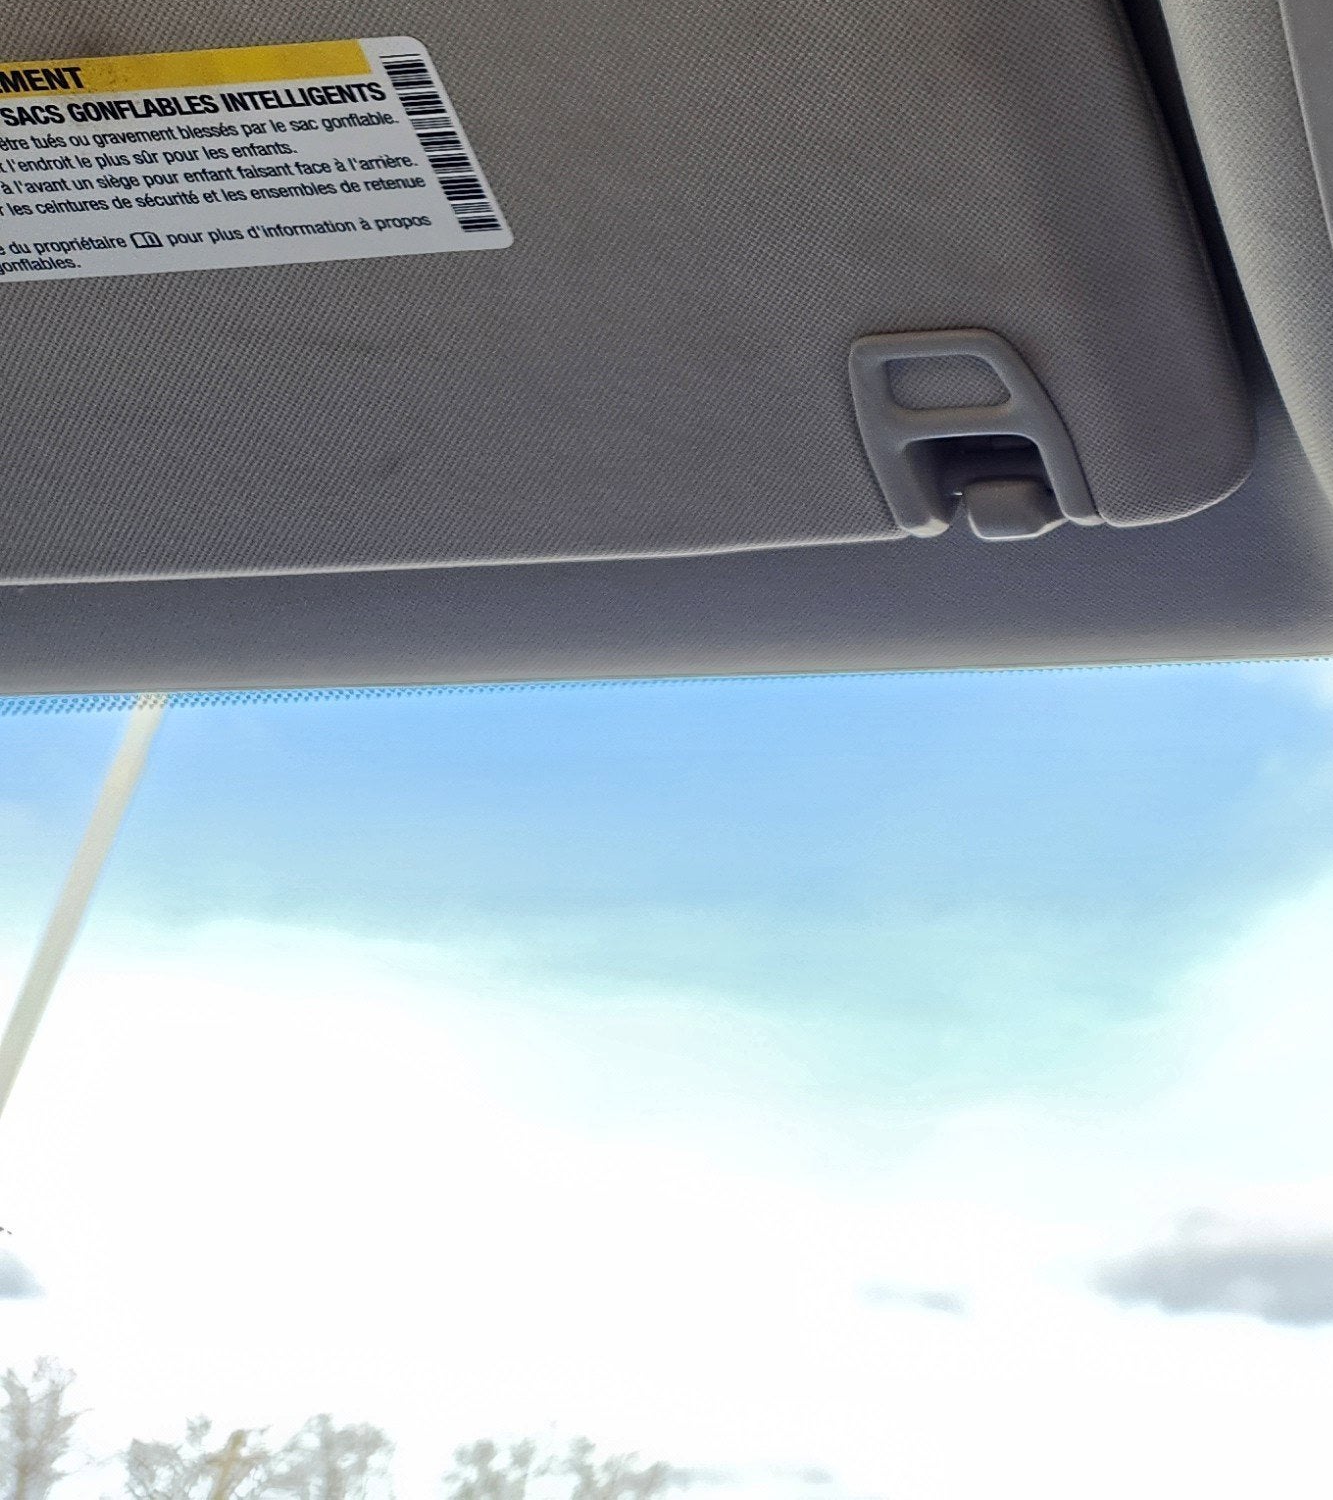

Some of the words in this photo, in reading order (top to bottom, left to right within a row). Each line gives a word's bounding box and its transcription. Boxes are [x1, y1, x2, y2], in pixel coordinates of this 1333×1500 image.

[0, 67, 83, 93] MENT
[0, 104, 65, 126] SACS
[67, 94, 219, 123] GONFLABLES
[220, 82, 386, 112] INTELLIGENTS
[30, 134, 67, 149] tués
[69, 134, 90, 147] ou
[92, 126, 176, 148] gravement
[176, 122, 244, 140] blessés
[241, 124, 267, 142] par
[270, 119, 286, 134] le
[290, 120, 319, 133] sac
[321, 112, 400, 133] gonflable.
[1, 178, 14, 195] à
[13, 177, 72, 194] l'avant
[72, 178, 94, 191] un
[96, 174, 140, 191] siège
[143, 172, 179, 188] pour
[184, 166, 237, 184] enfant
[236, 161, 293, 180] faisant
[294, 159, 332, 176] face
[334, 157, 346, 173] à
[348, 153, 418, 172] l'arrière.
[9, 155, 75, 173] l'endroit
[75, 154, 93, 169] le
[95, 152, 131, 170] plus
[133, 149, 160, 165] sûr
[162, 149, 199, 166] pour
[202, 146, 229, 161] les
[231, 141, 298, 159] enfants.
[7, 202, 33, 217] les
[35, 198, 109, 214] ceintures
[112, 196, 133, 210] de
[135, 190, 200, 208] sécurité
[202, 189, 222, 204] et
[222, 186, 248, 201] les
[250, 180, 338, 200] ensembles
[340, 180, 361, 194] de
[364, 175, 426, 192] retenue
[8, 241, 31, 256] du
[33, 235, 128, 257] propriétaire
[166, 231, 204, 248] pour
[208, 227, 244, 245] plus
[247, 218, 355, 240] d'information
[359, 216, 373, 231] à
[374, 214, 432, 232] propos
